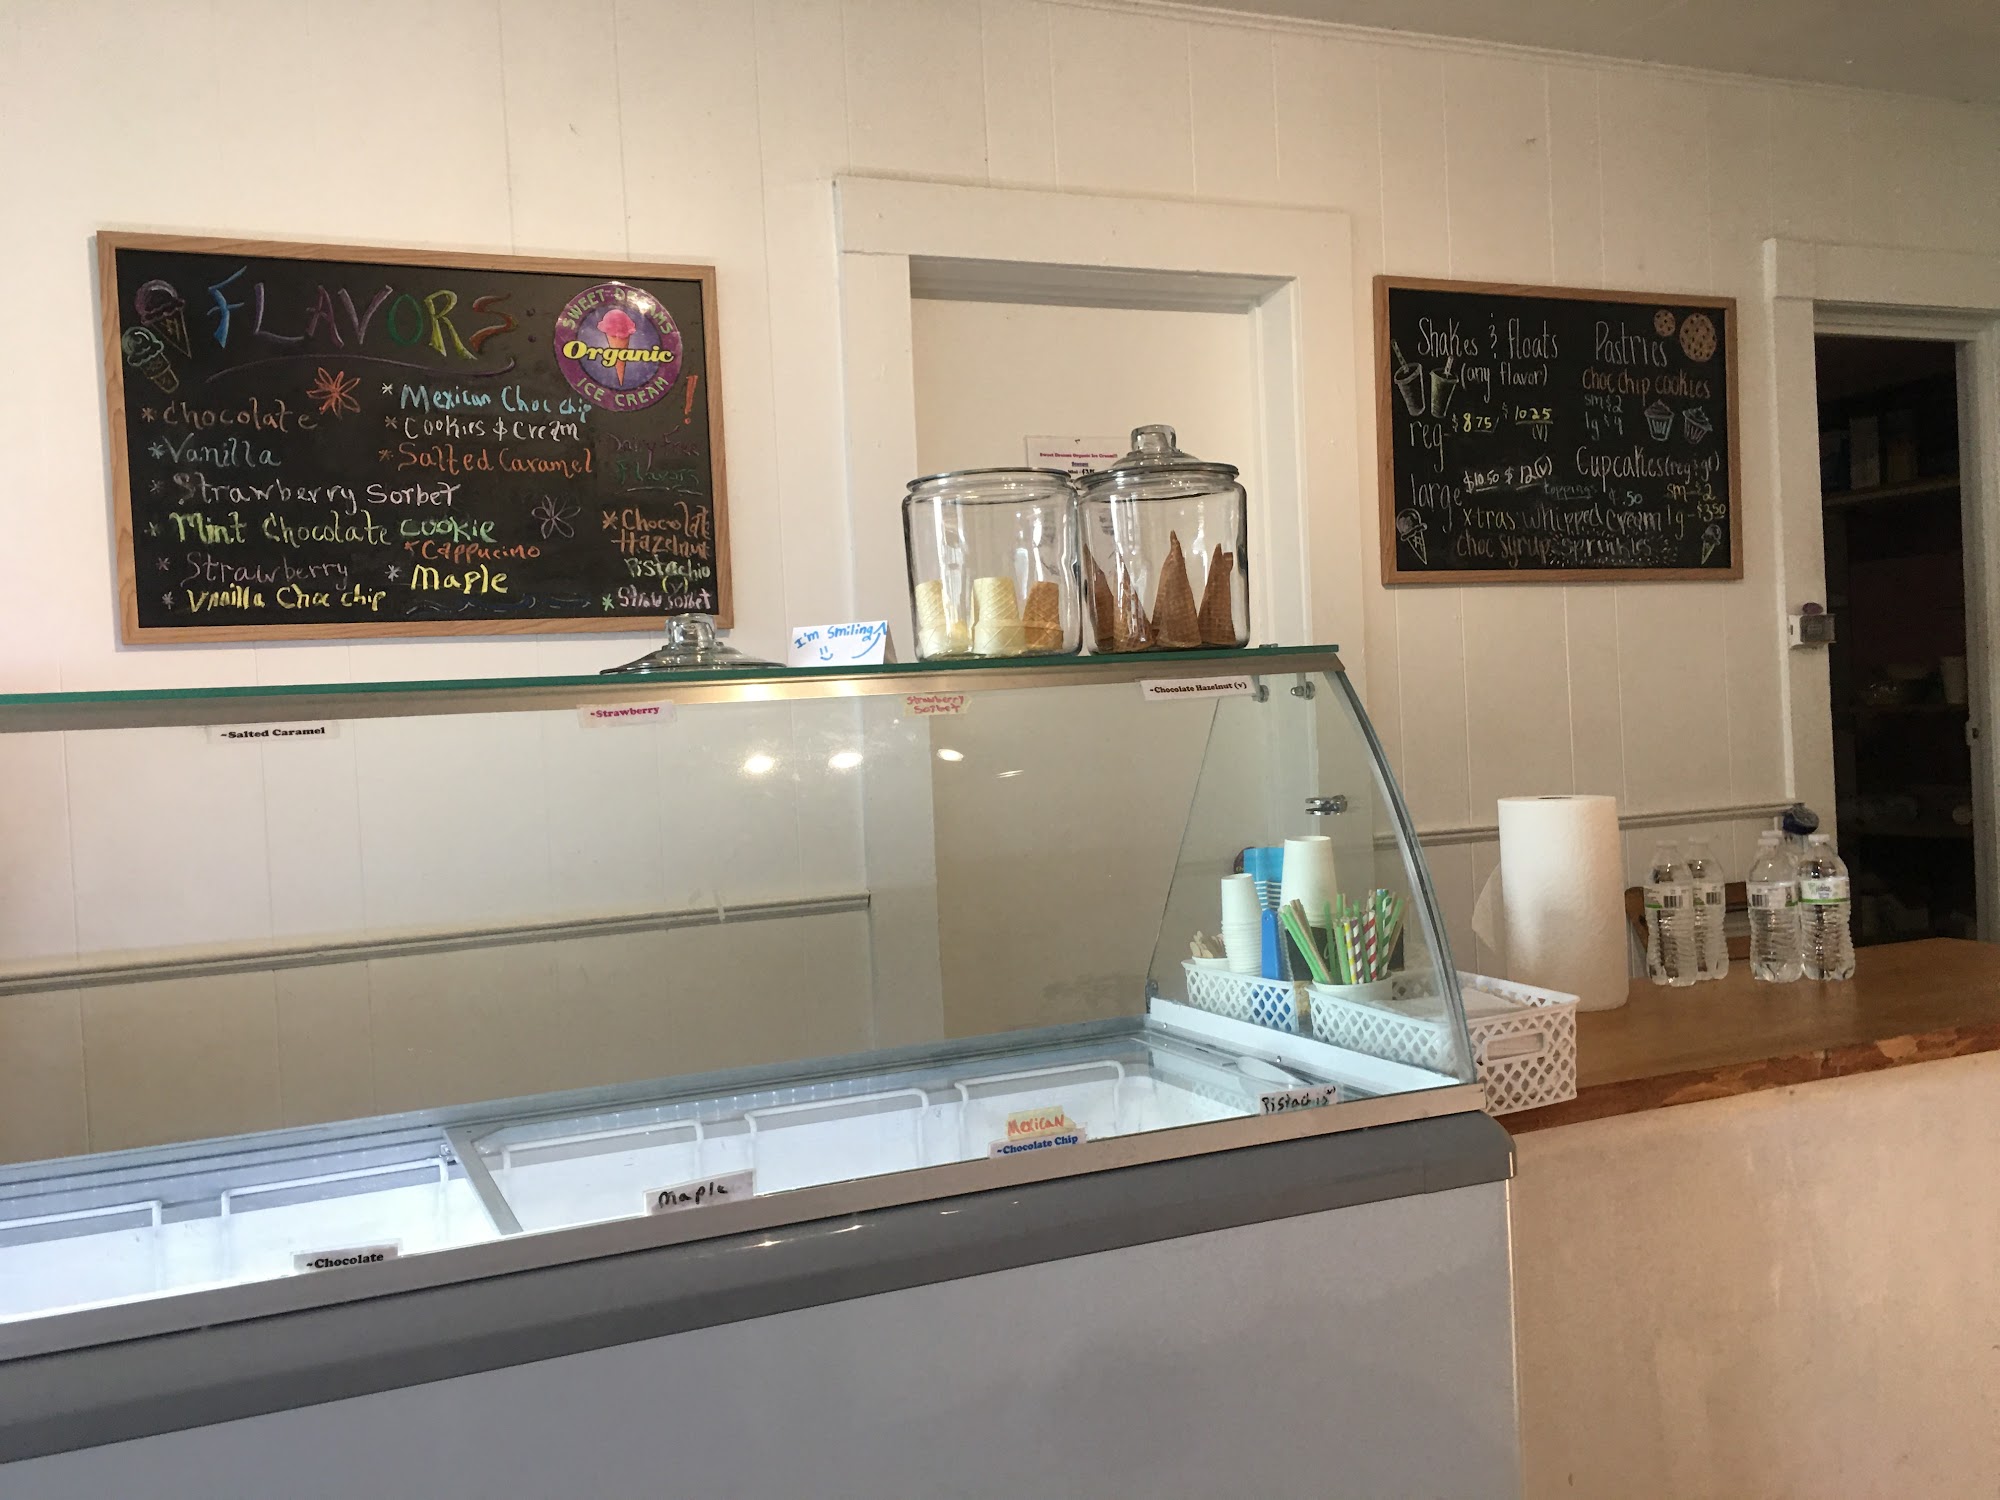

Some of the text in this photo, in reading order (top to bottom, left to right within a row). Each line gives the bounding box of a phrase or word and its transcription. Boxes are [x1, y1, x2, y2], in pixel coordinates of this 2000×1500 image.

[206, 265, 514, 361] FLAVORS
[562, 288, 610, 331] SWEET
[562, 340, 675, 367] Organic
[1418, 317, 1478, 357] Shakes
[1595, 320, 1668, 368] Pastries
[400, 385, 492, 413] Mexican
[576, 375, 670, 407] ICE CREAM
[1461, 361, 1548, 404] (any flavor)
[163, 397, 319, 433] Chocolate
[404, 415, 485, 439] Cookies
[163, 432, 281, 467] Vanilla
[397, 442, 592, 479] Salted Caramel
[1576, 445, 1663, 492] Cupcakes
[172, 472, 358, 515] Strawberry
[1411, 473, 1463, 533] large
[168, 512, 247, 544] Mint
[262, 509, 391, 549] Chocolate
[1522, 502, 1603, 536] whipped
[1498, 532, 1551, 568] syrup
[181, 551, 348, 590] Strawberry
[411, 563, 509, 595] Maple
[794, 623, 874, 649] I'm Smiling
[1196, 683, 1233, 692] Hazelnut
[272, 727, 326, 737] Caramel
[1054, 1134, 1079, 1145] Chip
